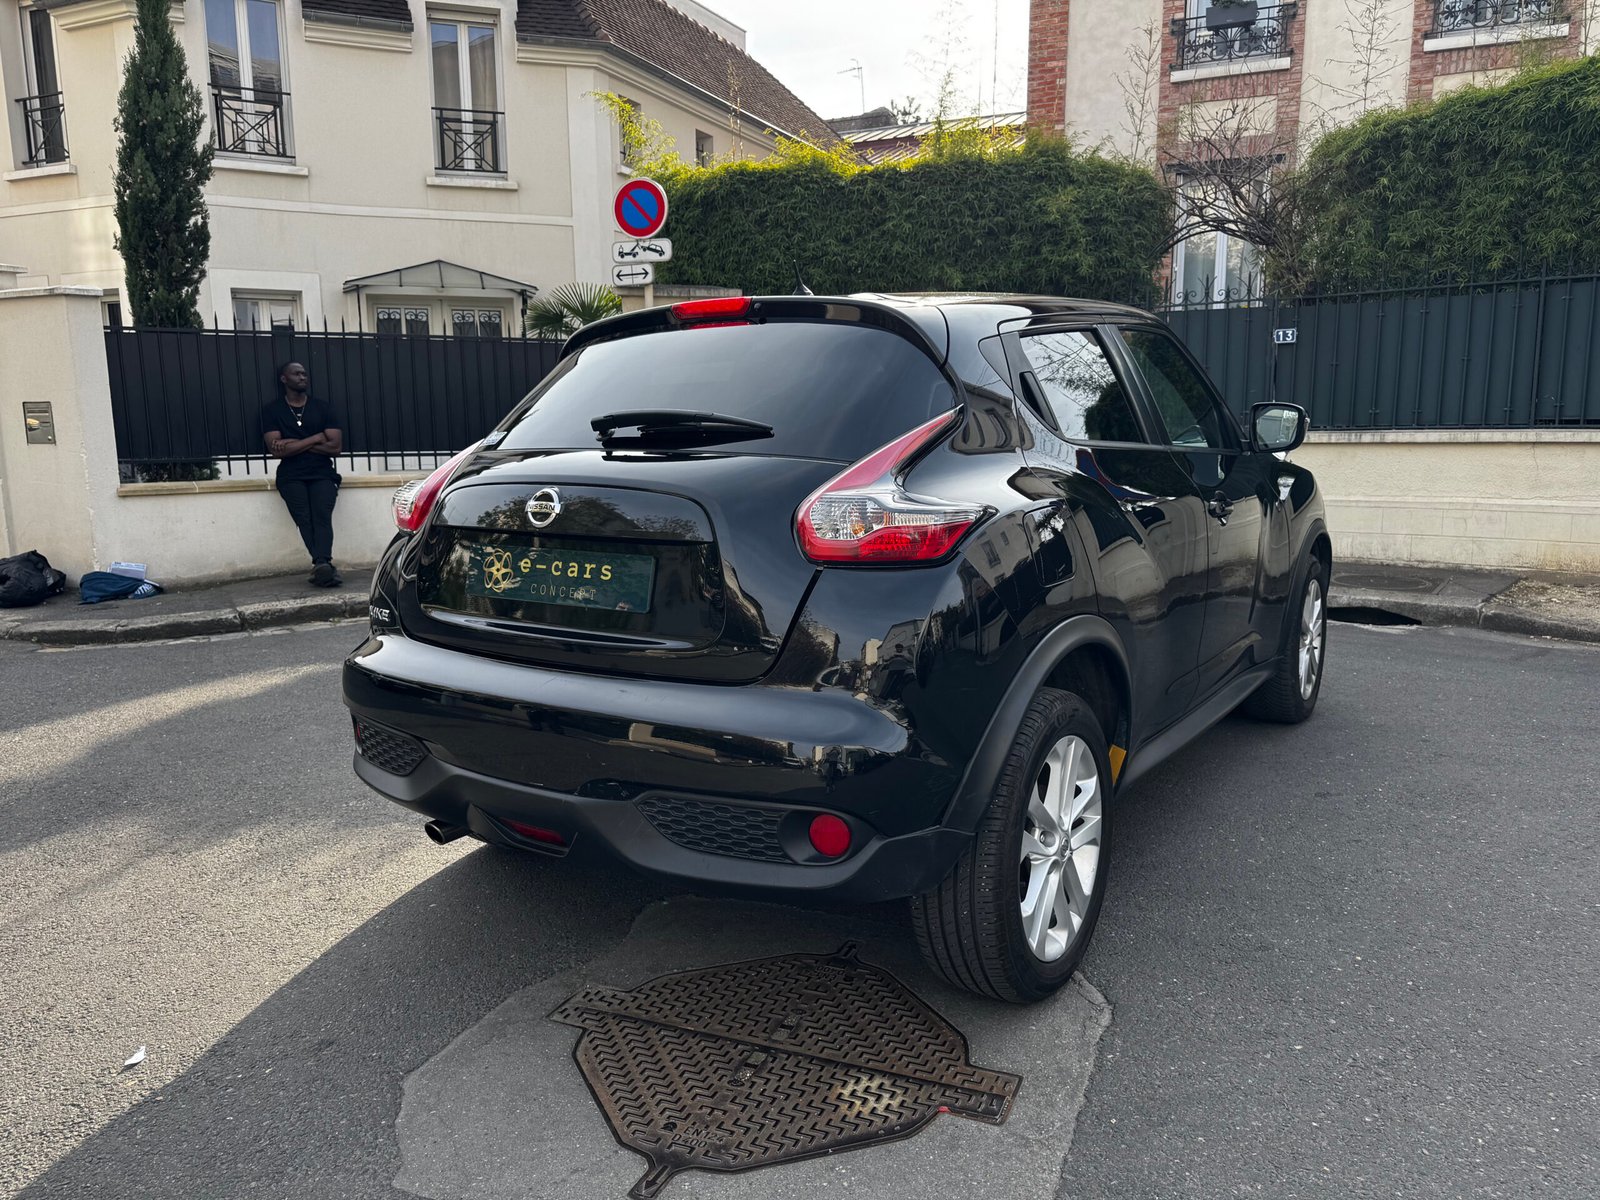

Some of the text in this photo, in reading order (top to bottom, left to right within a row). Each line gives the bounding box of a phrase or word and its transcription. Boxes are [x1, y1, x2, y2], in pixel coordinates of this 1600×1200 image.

[1278, 330, 1293, 341] 13
[519, 558, 612, 580] e-cars
[530, 583, 597, 600] CONCEPT
